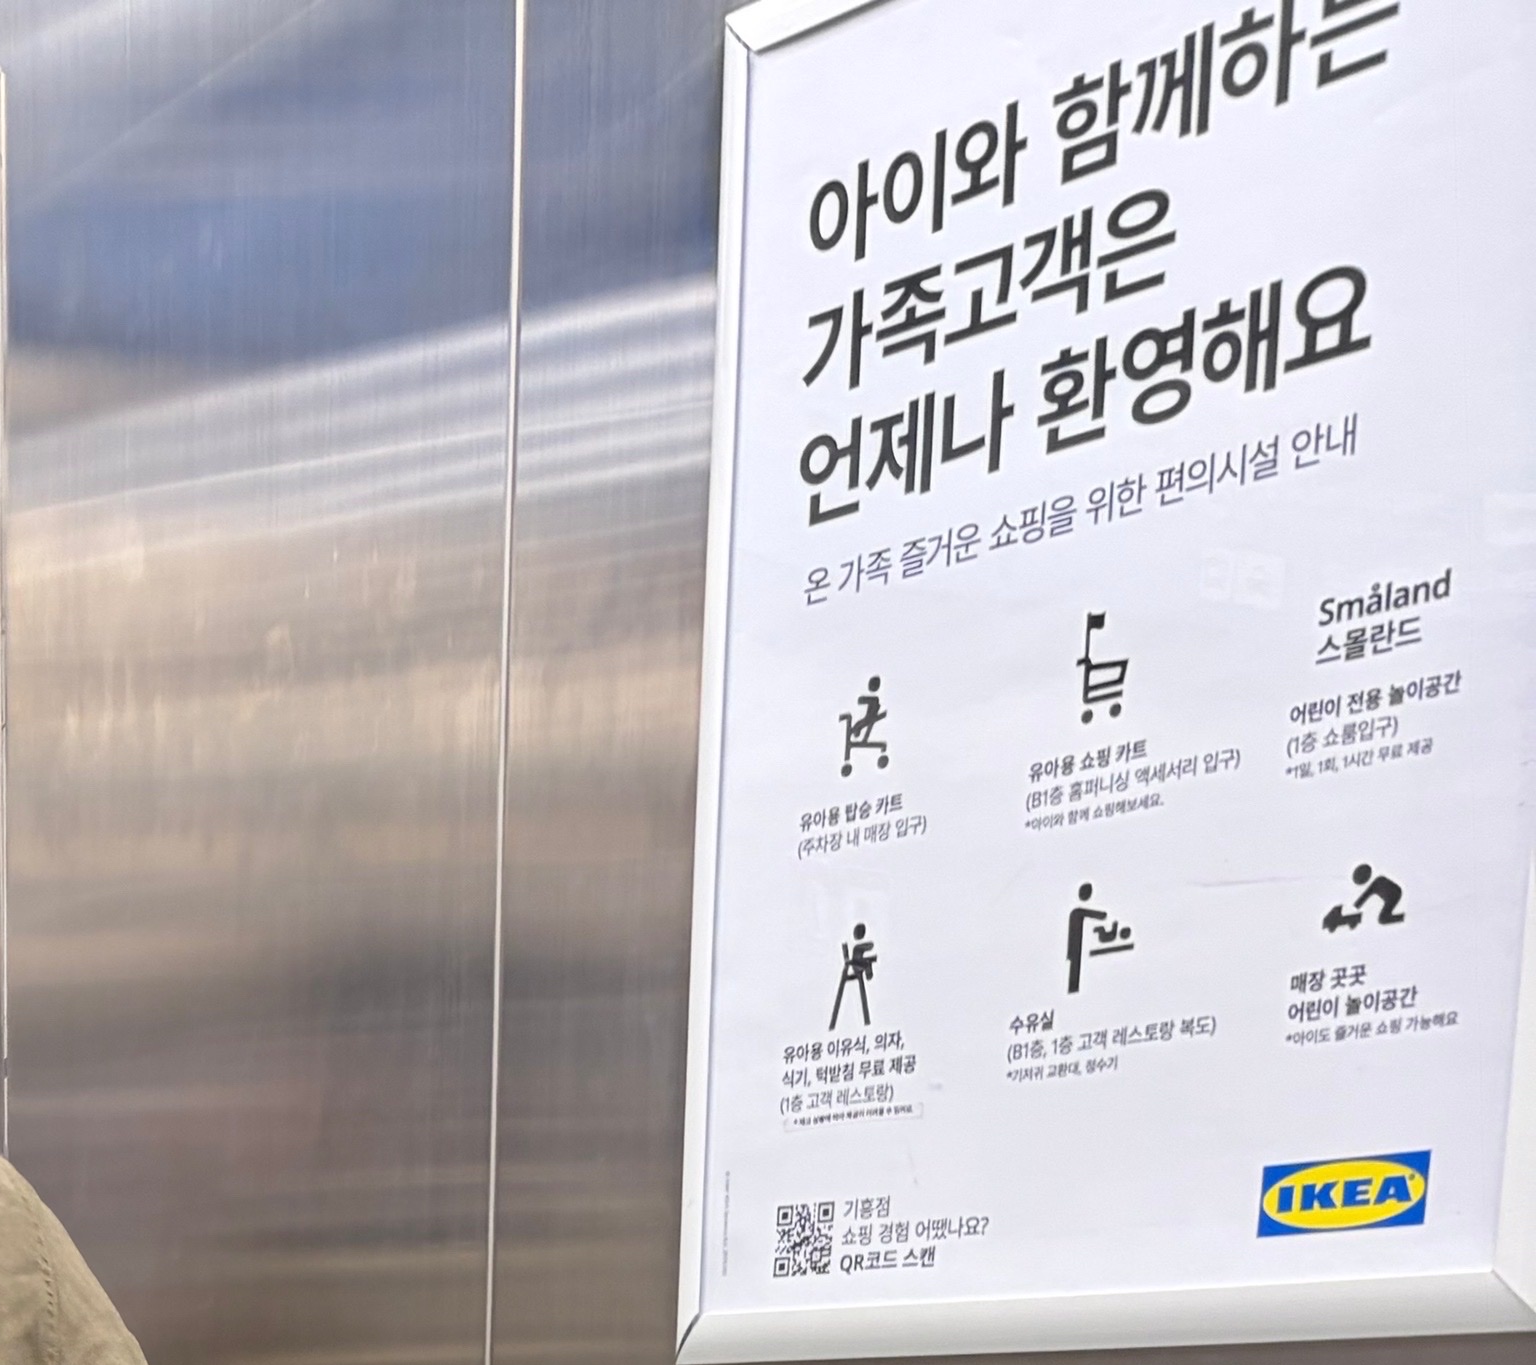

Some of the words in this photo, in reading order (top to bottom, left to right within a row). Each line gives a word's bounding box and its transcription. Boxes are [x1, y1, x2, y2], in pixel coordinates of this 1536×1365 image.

[809, 99, 1028, 262] 아이와
[1053, 0, 1400, 185] 함께하는
[802, 188, 1176, 390] 가족고객은
[799, 368, 1015, 527] 언제나
[1037, 266, 1372, 455] 환영해요
[804, 567, 831, 605] 온
[838, 549, 892, 595] 가족
[900, 523, 981, 578] 즐거운
[989, 495, 1078, 550] 쇼핑을
[1085, 473, 1147, 524] 위한
[1155, 435, 1280, 506] 편의시설
[1293, 414, 1358, 468] 안내
[1318, 568, 1452, 627] Småland
[1315, 616, 1422, 665] 스몰란드
[1290, 695, 1341, 725] 어린이
[1347, 688, 1382, 715] 전용
[1389, 670, 1462, 706] 놀이공간
[1286, 732, 1317, 758] (1층
[1323, 716, 1399, 748] 쇼룸입구)
[1344, 749, 1374, 769] 1시간
[1377, 743, 1403, 762] 무료
[1026, 785, 1064, 812] (B1층
[1068, 770, 1130, 802] 홈퍼니싱
[1135, 755, 1198, 786] 액세서리
[1203, 749, 1241, 774] 입구)
[1028, 755, 1075, 783] 유아용
[1079, 746, 1111, 771] 쇼핑
[1115, 738, 1148, 762] 카트
[800, 805, 840, 833] 유아용
[845, 800, 872, 823] 탑승
[875, 793, 903, 815] 카트
[798, 830, 843, 860] (주차장
[846, 826, 860, 847] 내
[864, 821, 892, 843] 매장
[895, 815, 927, 839] 입구)
[1290, 968, 1326, 993] 매장
[1330, 963, 1367, 989] 곳곳
[1009, 1008, 1055, 1036] 수유실
[1288, 996, 1340, 1023] 어린이
[1345, 985, 1418, 1016] 놀이공간
[783, 1042, 823, 1064] 유아용
[827, 1034, 870, 1058] 이유식,
[874, 1030, 905, 1051] 의자,
[1053, 1035, 1073, 1055] 1층
[1077, 1028, 1108, 1051] 고객
[1112, 1018, 1175, 1046] 레스토랑
[1180, 1015, 1217, 1037] 복도)
[1334, 1022, 1372, 1041] 즐거운
[1375, 1016, 1403, 1035] 쇼핑
[782, 1067, 811, 1088] 식기,
[858, 1058, 885, 1079] 무료
[889, 1053, 917, 1075] 제공
[780, 1094, 803, 1115] (1층
[806, 1088, 833, 1110] 고객
[836, 1081, 894, 1106] 레스토랑)
[843, 1195, 891, 1221] 기흥점
[1276, 1174, 1414, 1214] IKEA
[841, 1225, 873, 1248] 쇼핑
[878, 1220, 910, 1245] 경험
[915, 1216, 990, 1242] 어땠나요?
[840, 1249, 898, 1274] QR코드
[902, 1246, 936, 1269] 스캔
